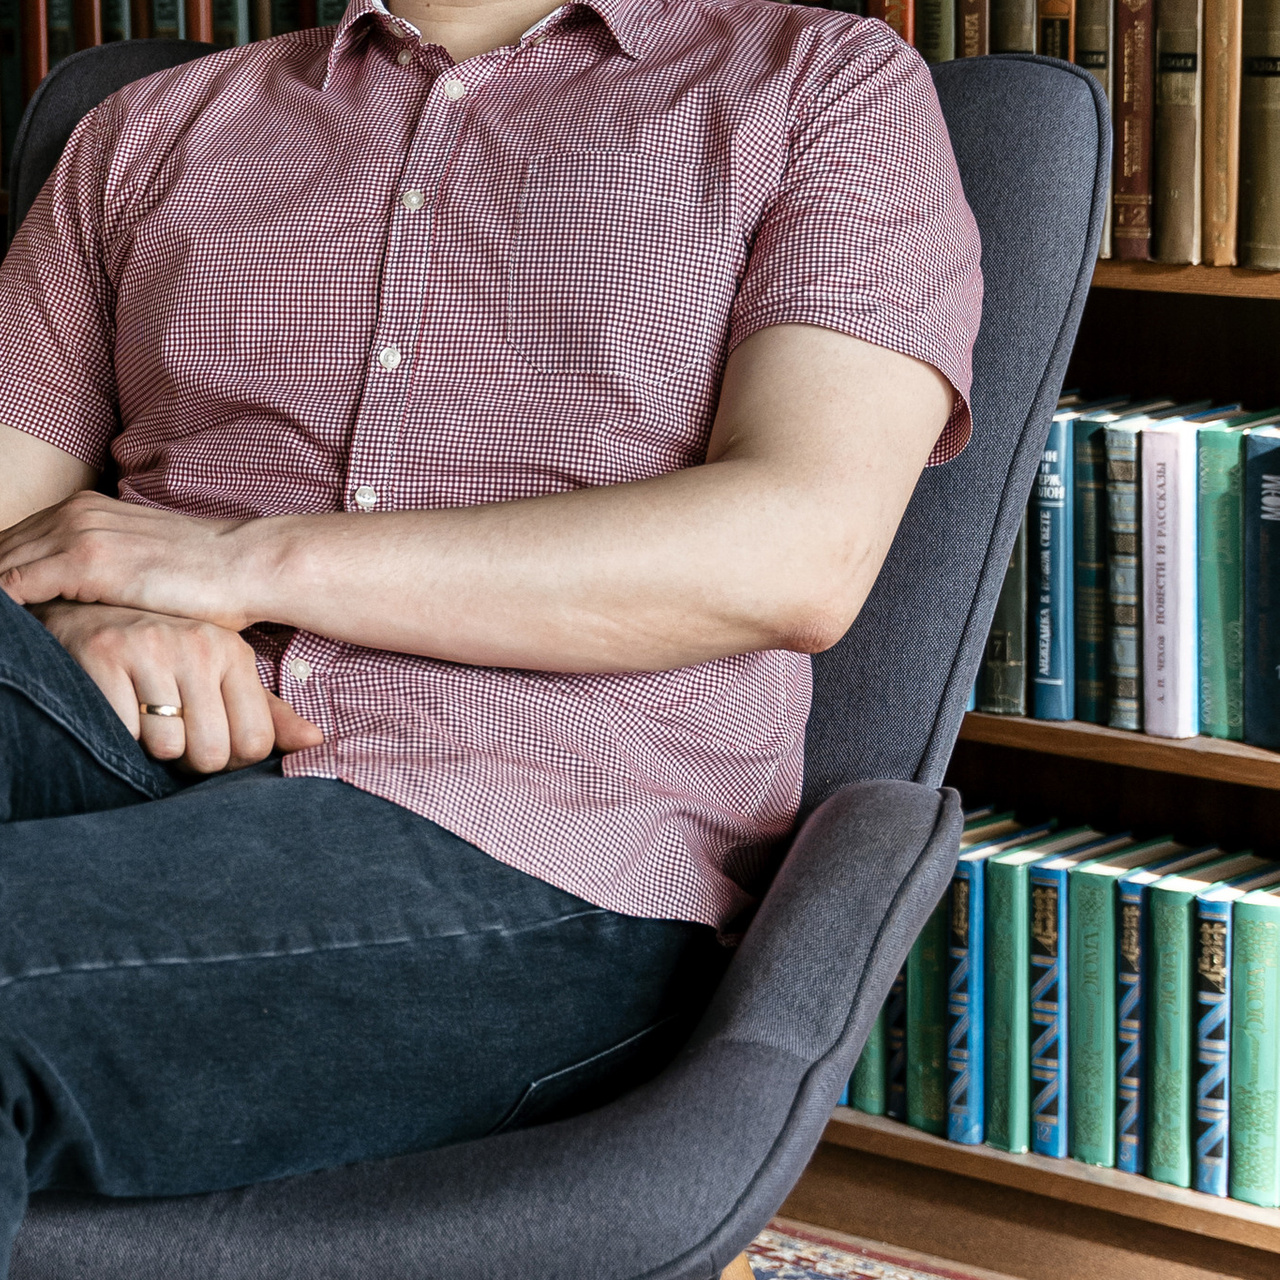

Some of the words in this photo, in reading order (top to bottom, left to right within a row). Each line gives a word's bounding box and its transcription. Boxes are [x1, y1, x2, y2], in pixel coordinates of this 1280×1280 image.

[1155, 461, 1168, 538] РАССКАЗЫ
[1039, 510, 1052, 547] СВЕТЕ
[1156, 545, 1166, 555] И
[1041, 595, 1051, 604] В
[1154, 562, 1167, 625] ПОВЕСТИ
[1037, 608, 1051, 676] АНЖЕЛИКА
[1156, 635, 1166, 672] ЧЕХОВ
